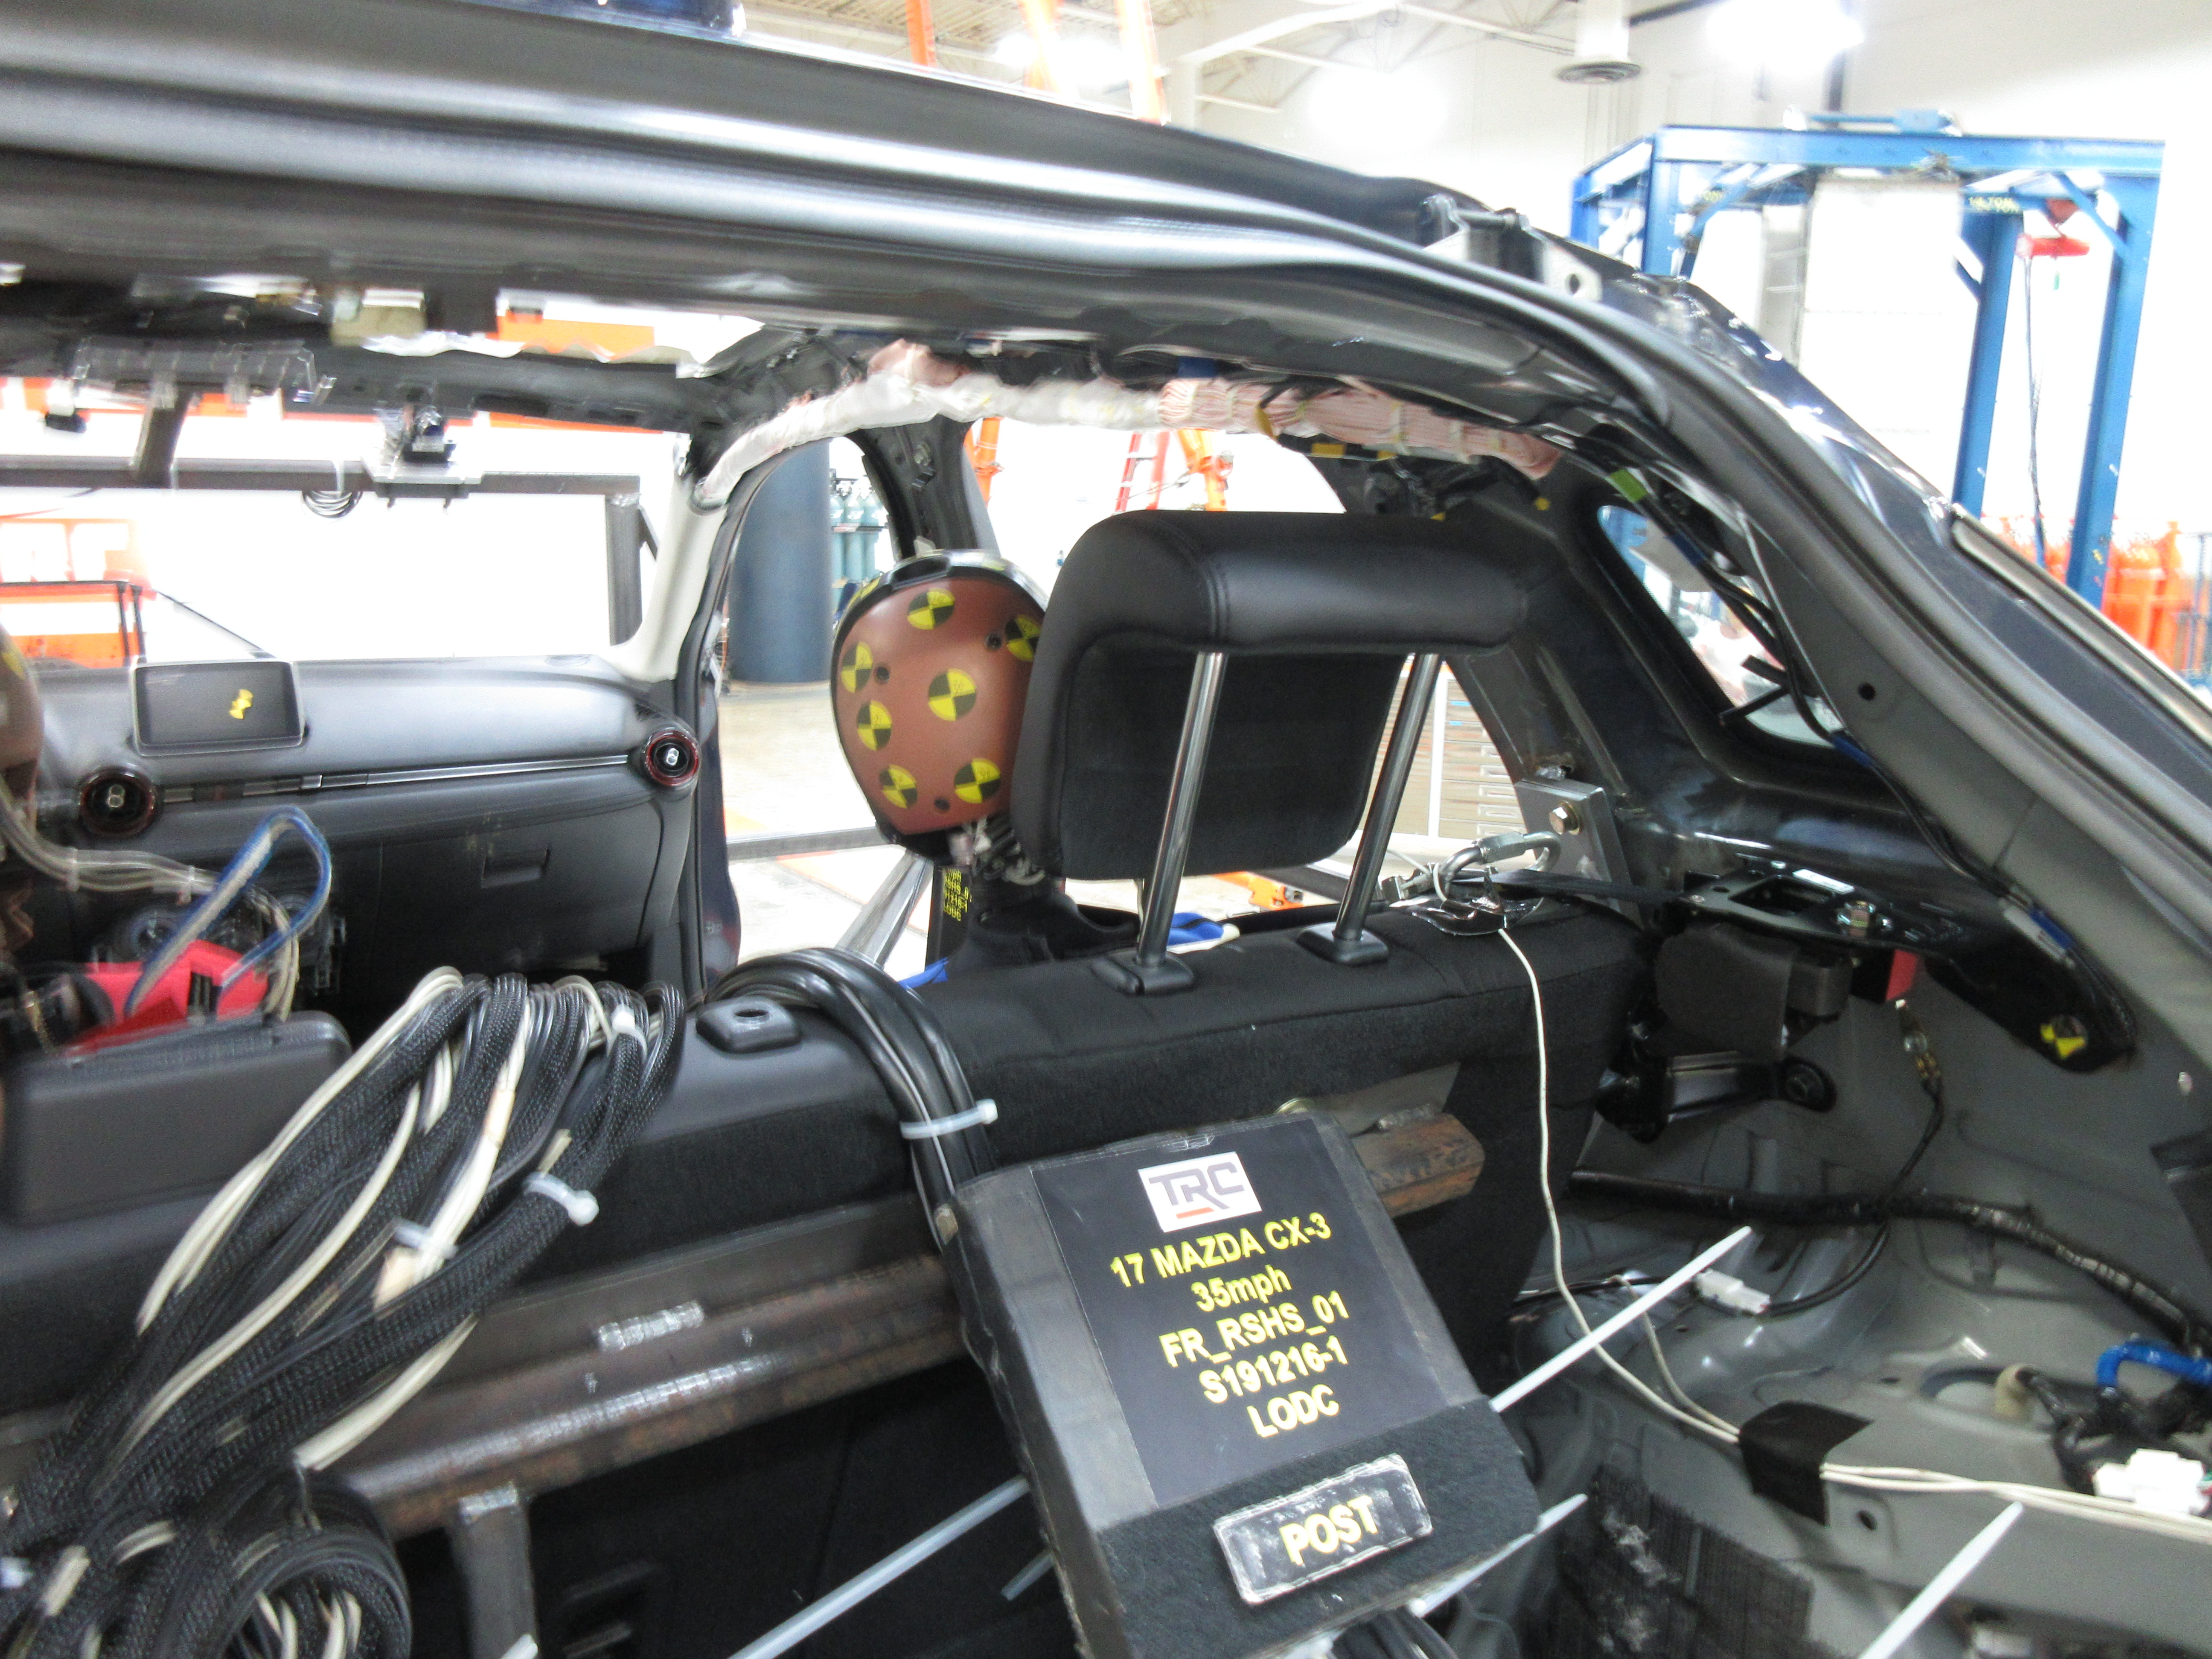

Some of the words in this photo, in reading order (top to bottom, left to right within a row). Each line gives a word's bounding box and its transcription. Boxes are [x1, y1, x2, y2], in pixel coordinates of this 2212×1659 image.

[1148, 1162, 1245, 1210] TRC
[1110, 1252, 1145, 1287] 17
[1150, 1228, 1266, 1278] MAZDA
[1264, 1212, 1331, 1250] CX-3
[1191, 1264, 1292, 1312] 35mph
[1159, 1290, 1350, 1367] FR_RSHS_01
[1199, 1335, 1349, 1403] S191216-1
[1246, 1384, 1339, 1438] LODC
[1279, 1495, 1379, 1566] POST
